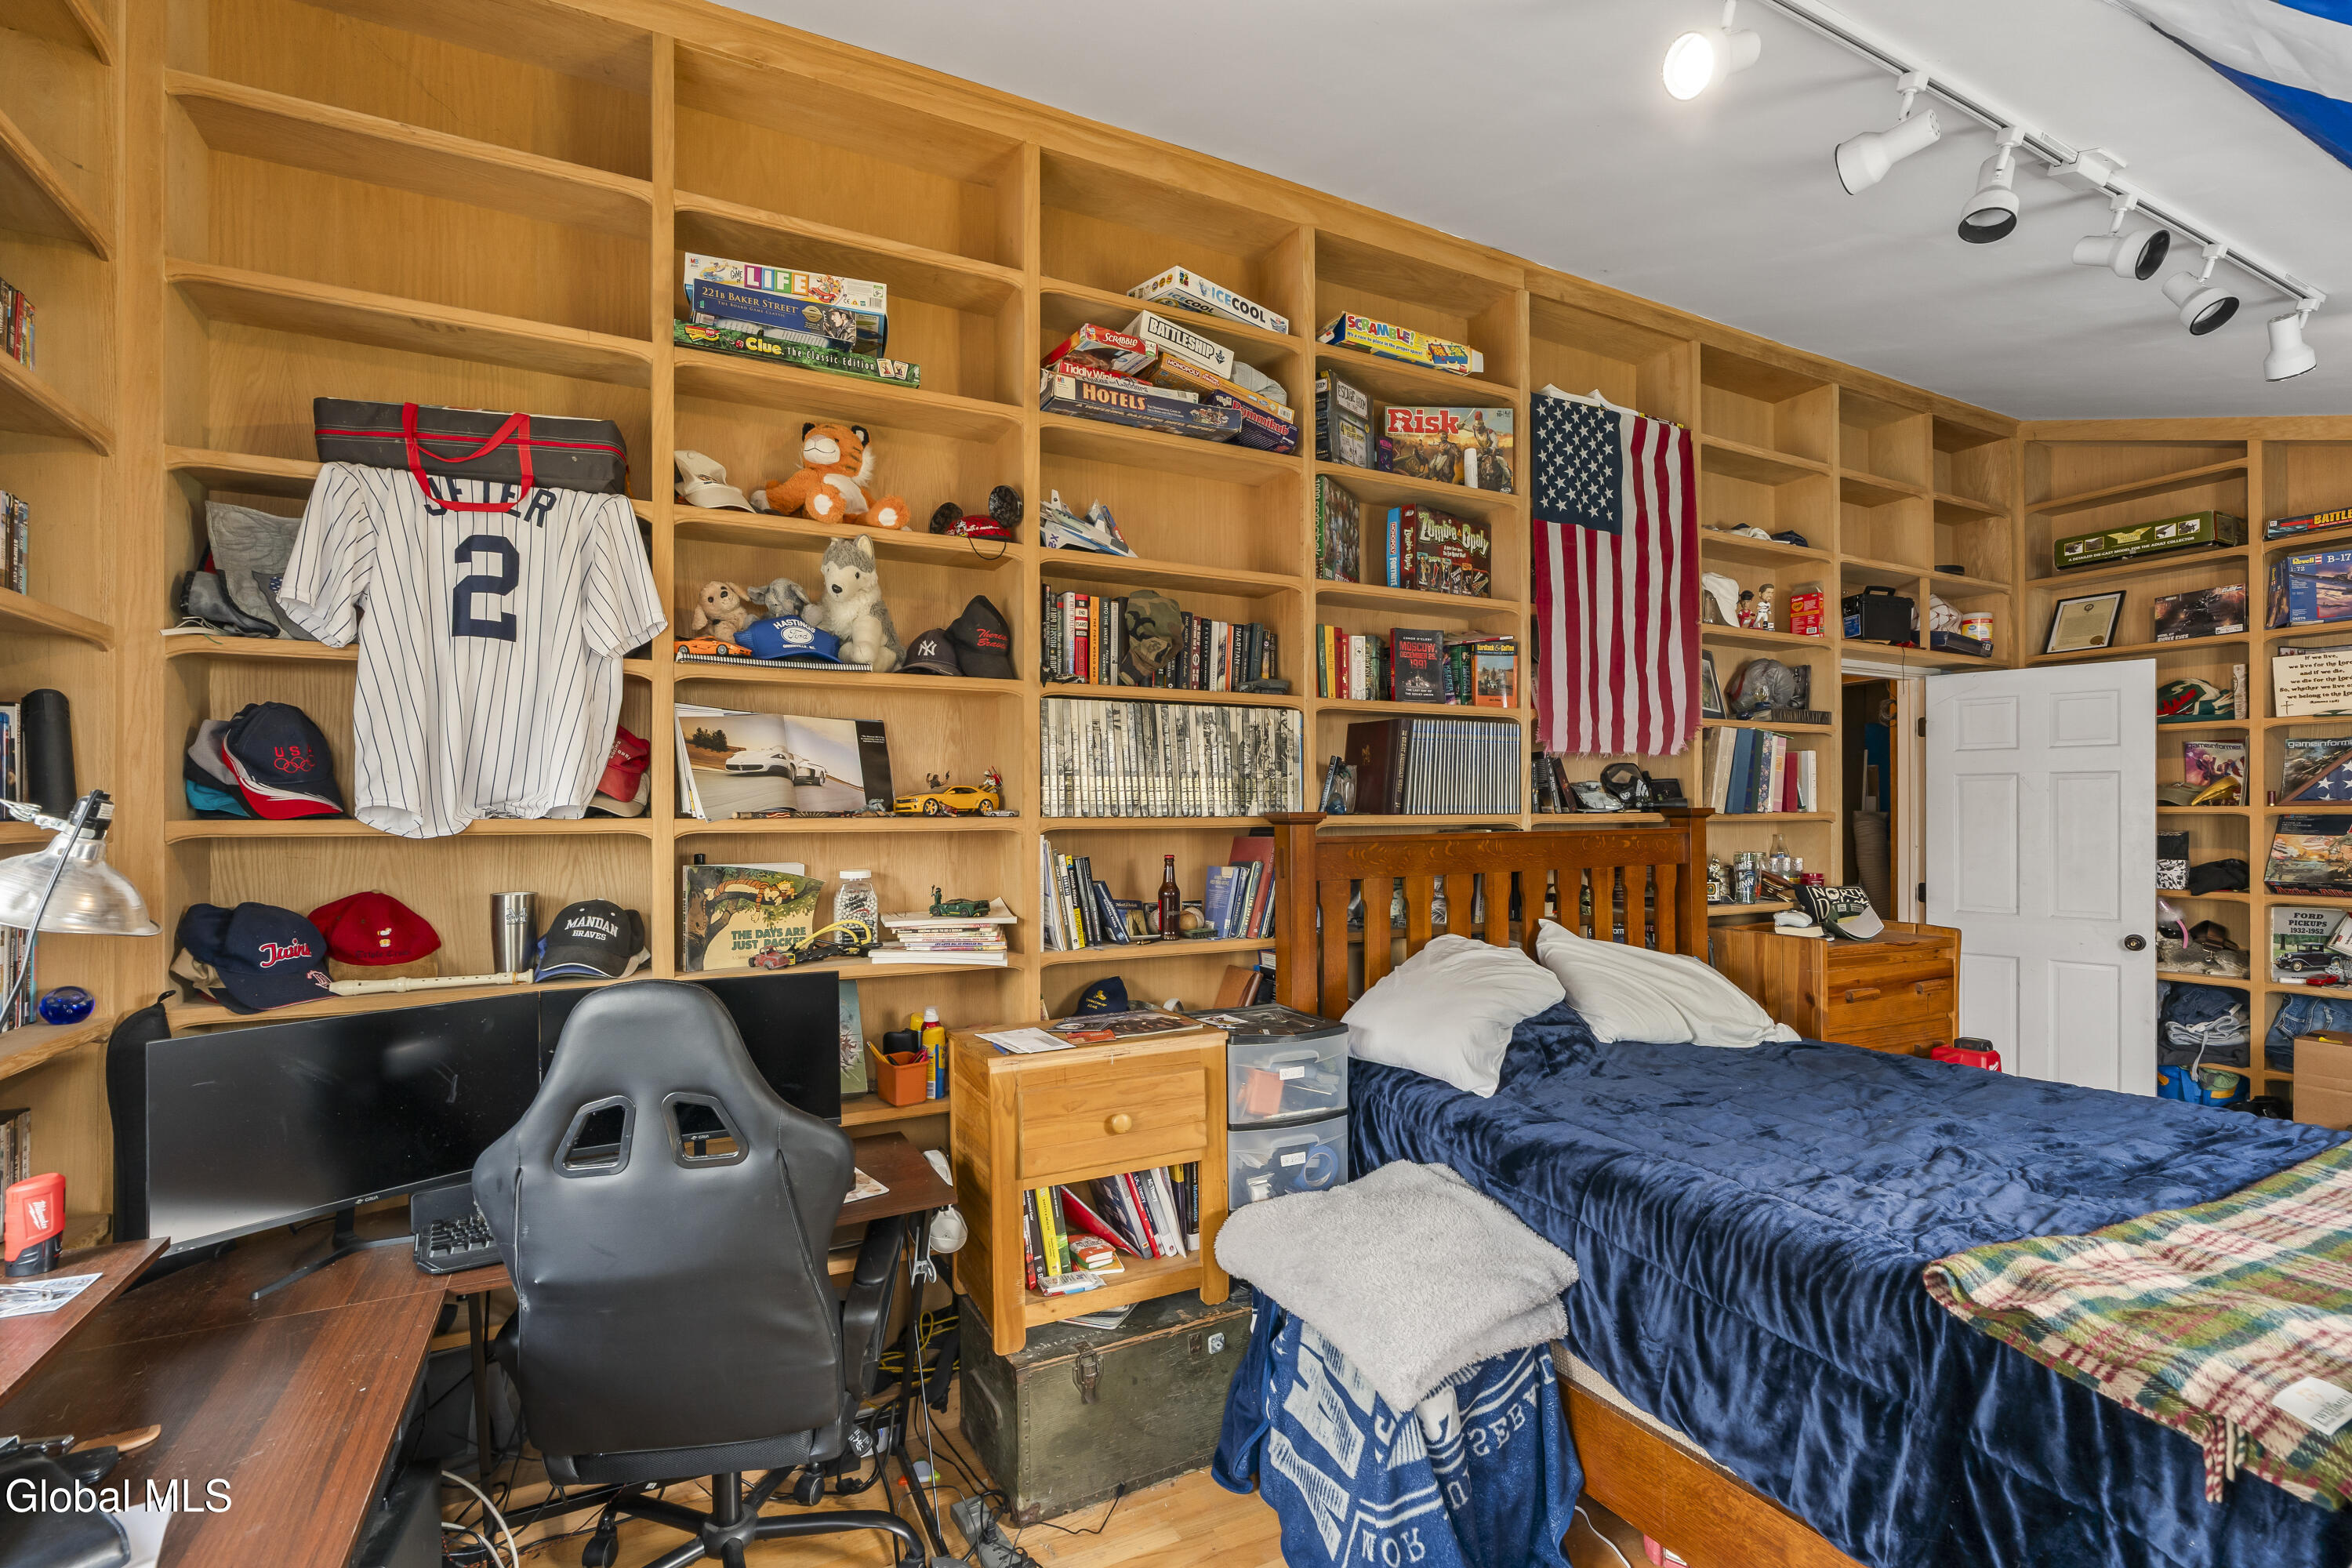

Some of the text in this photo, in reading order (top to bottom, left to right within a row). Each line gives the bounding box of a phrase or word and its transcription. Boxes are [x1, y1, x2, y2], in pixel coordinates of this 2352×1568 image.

[746, 267, 807, 294] LIFE
[729, 292, 759, 306] BAKER
[763, 299, 797, 314] STREET
[1211, 287, 1266, 324] ICECOOL
[1149, 317, 1214, 359] BATTLESHIP
[1348, 315, 1414, 345] SCRAMBLE!
[746, 337, 874, 370] Clue The Classic Edition
[1064, 362, 1092, 377] Tiddly
[1167, 359, 1200, 377] MONOPOLY
[1083, 382, 1146, 411] HOTELS
[1338, 384, 1356, 402] ESCAPE
[1388, 408, 1459, 434] Risk
[1418, 513, 1457, 543] Zombie
[2167, 536, 2194, 545] COLLECTOR
[2327, 554, 2350, 563] B-17
[452, 534, 520, 643] 2
[772, 619, 816, 633] HASTINGS
[787, 629, 808, 641] Ford
[917, 640, 938, 655] NY
[1399, 641, 1437, 653] MOSCOW,
[1410, 659, 1427, 670] 1991
[1811, 886, 1867, 900] NORTH
[564, 916, 619, 938] MANDAN
[572, 930, 607, 941] BRAVES
[731, 927, 806, 940] THE DAYS ARE
[259, 938, 312, 967] Twins
[731, 940, 758, 950] JUST
[1138, 1185, 1146, 1203] Theory
